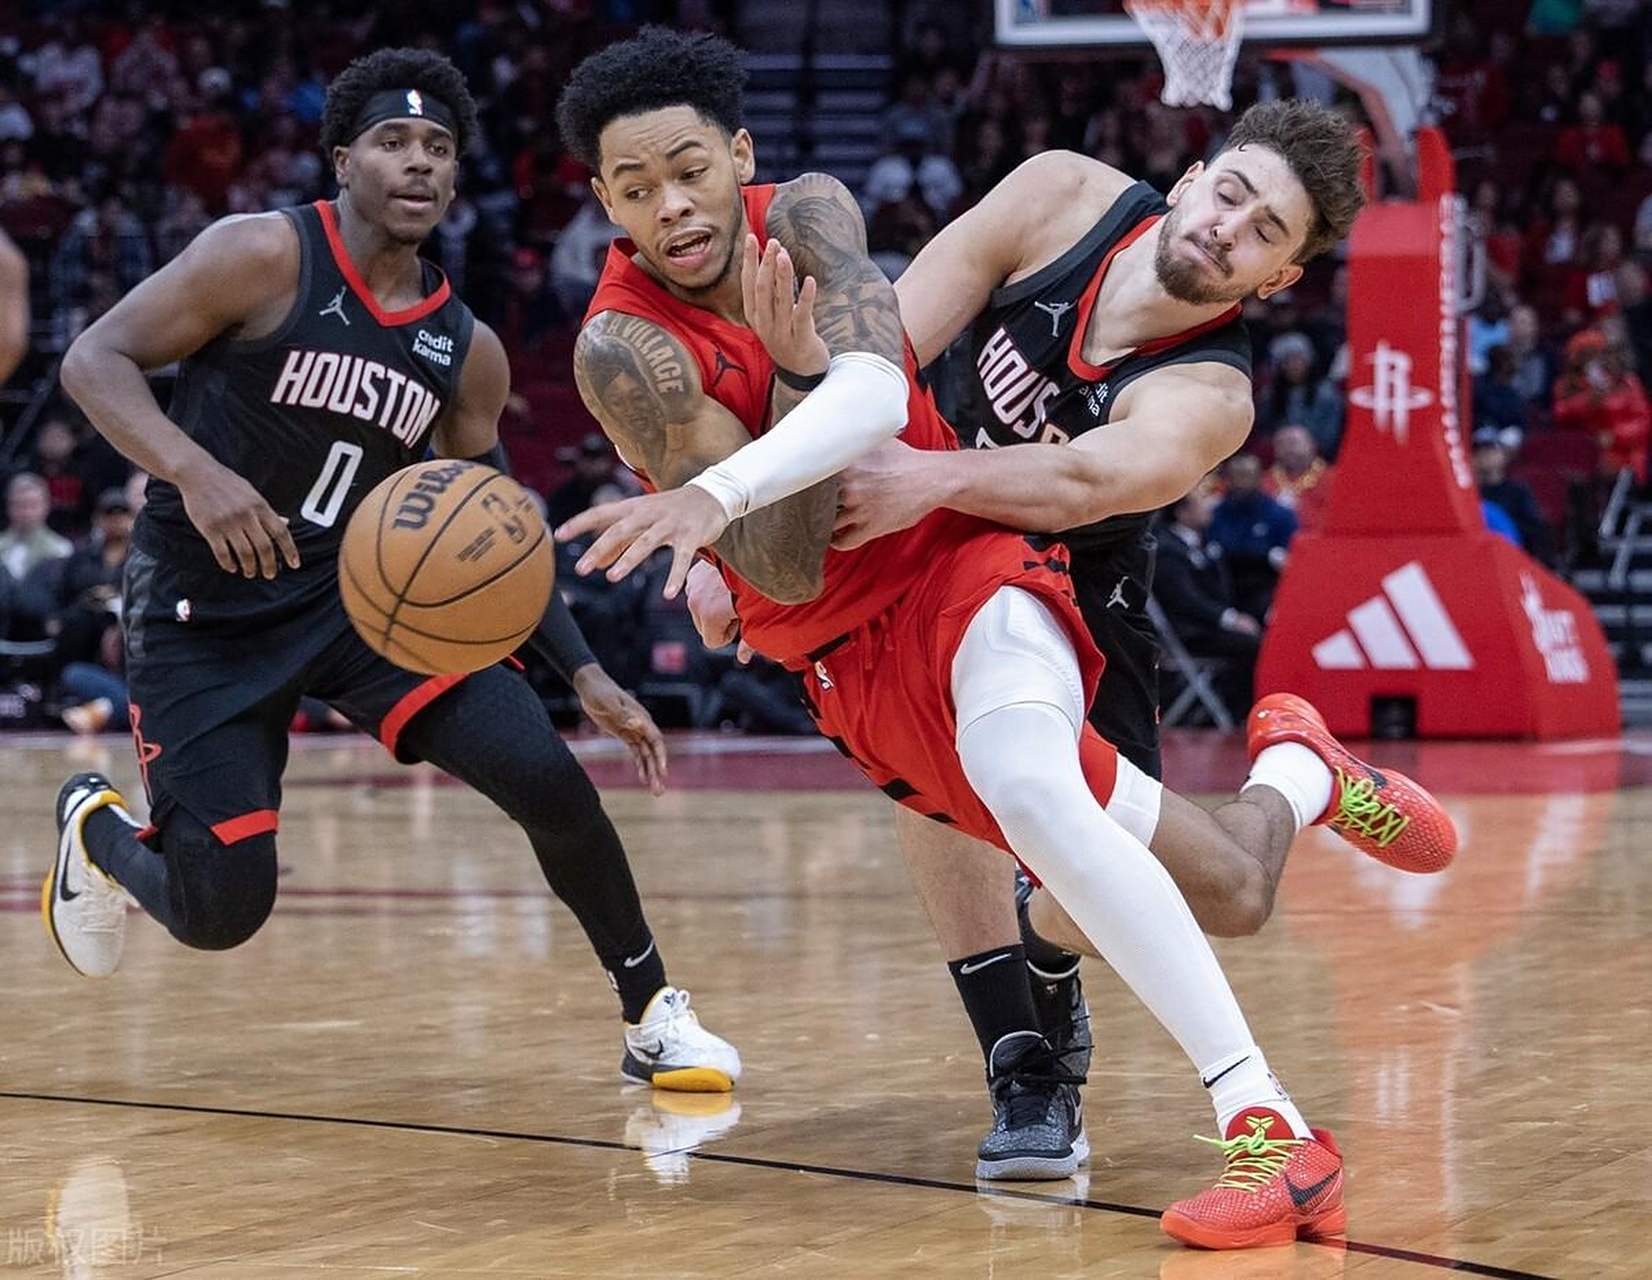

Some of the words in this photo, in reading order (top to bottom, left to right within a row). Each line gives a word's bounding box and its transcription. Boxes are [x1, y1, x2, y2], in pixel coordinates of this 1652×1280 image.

[412, 337, 452, 366] karma
[622, 319, 685, 394] VILLAGE
[269, 350, 442, 450] HOUSTON
[300, 440, 365, 528] 0
